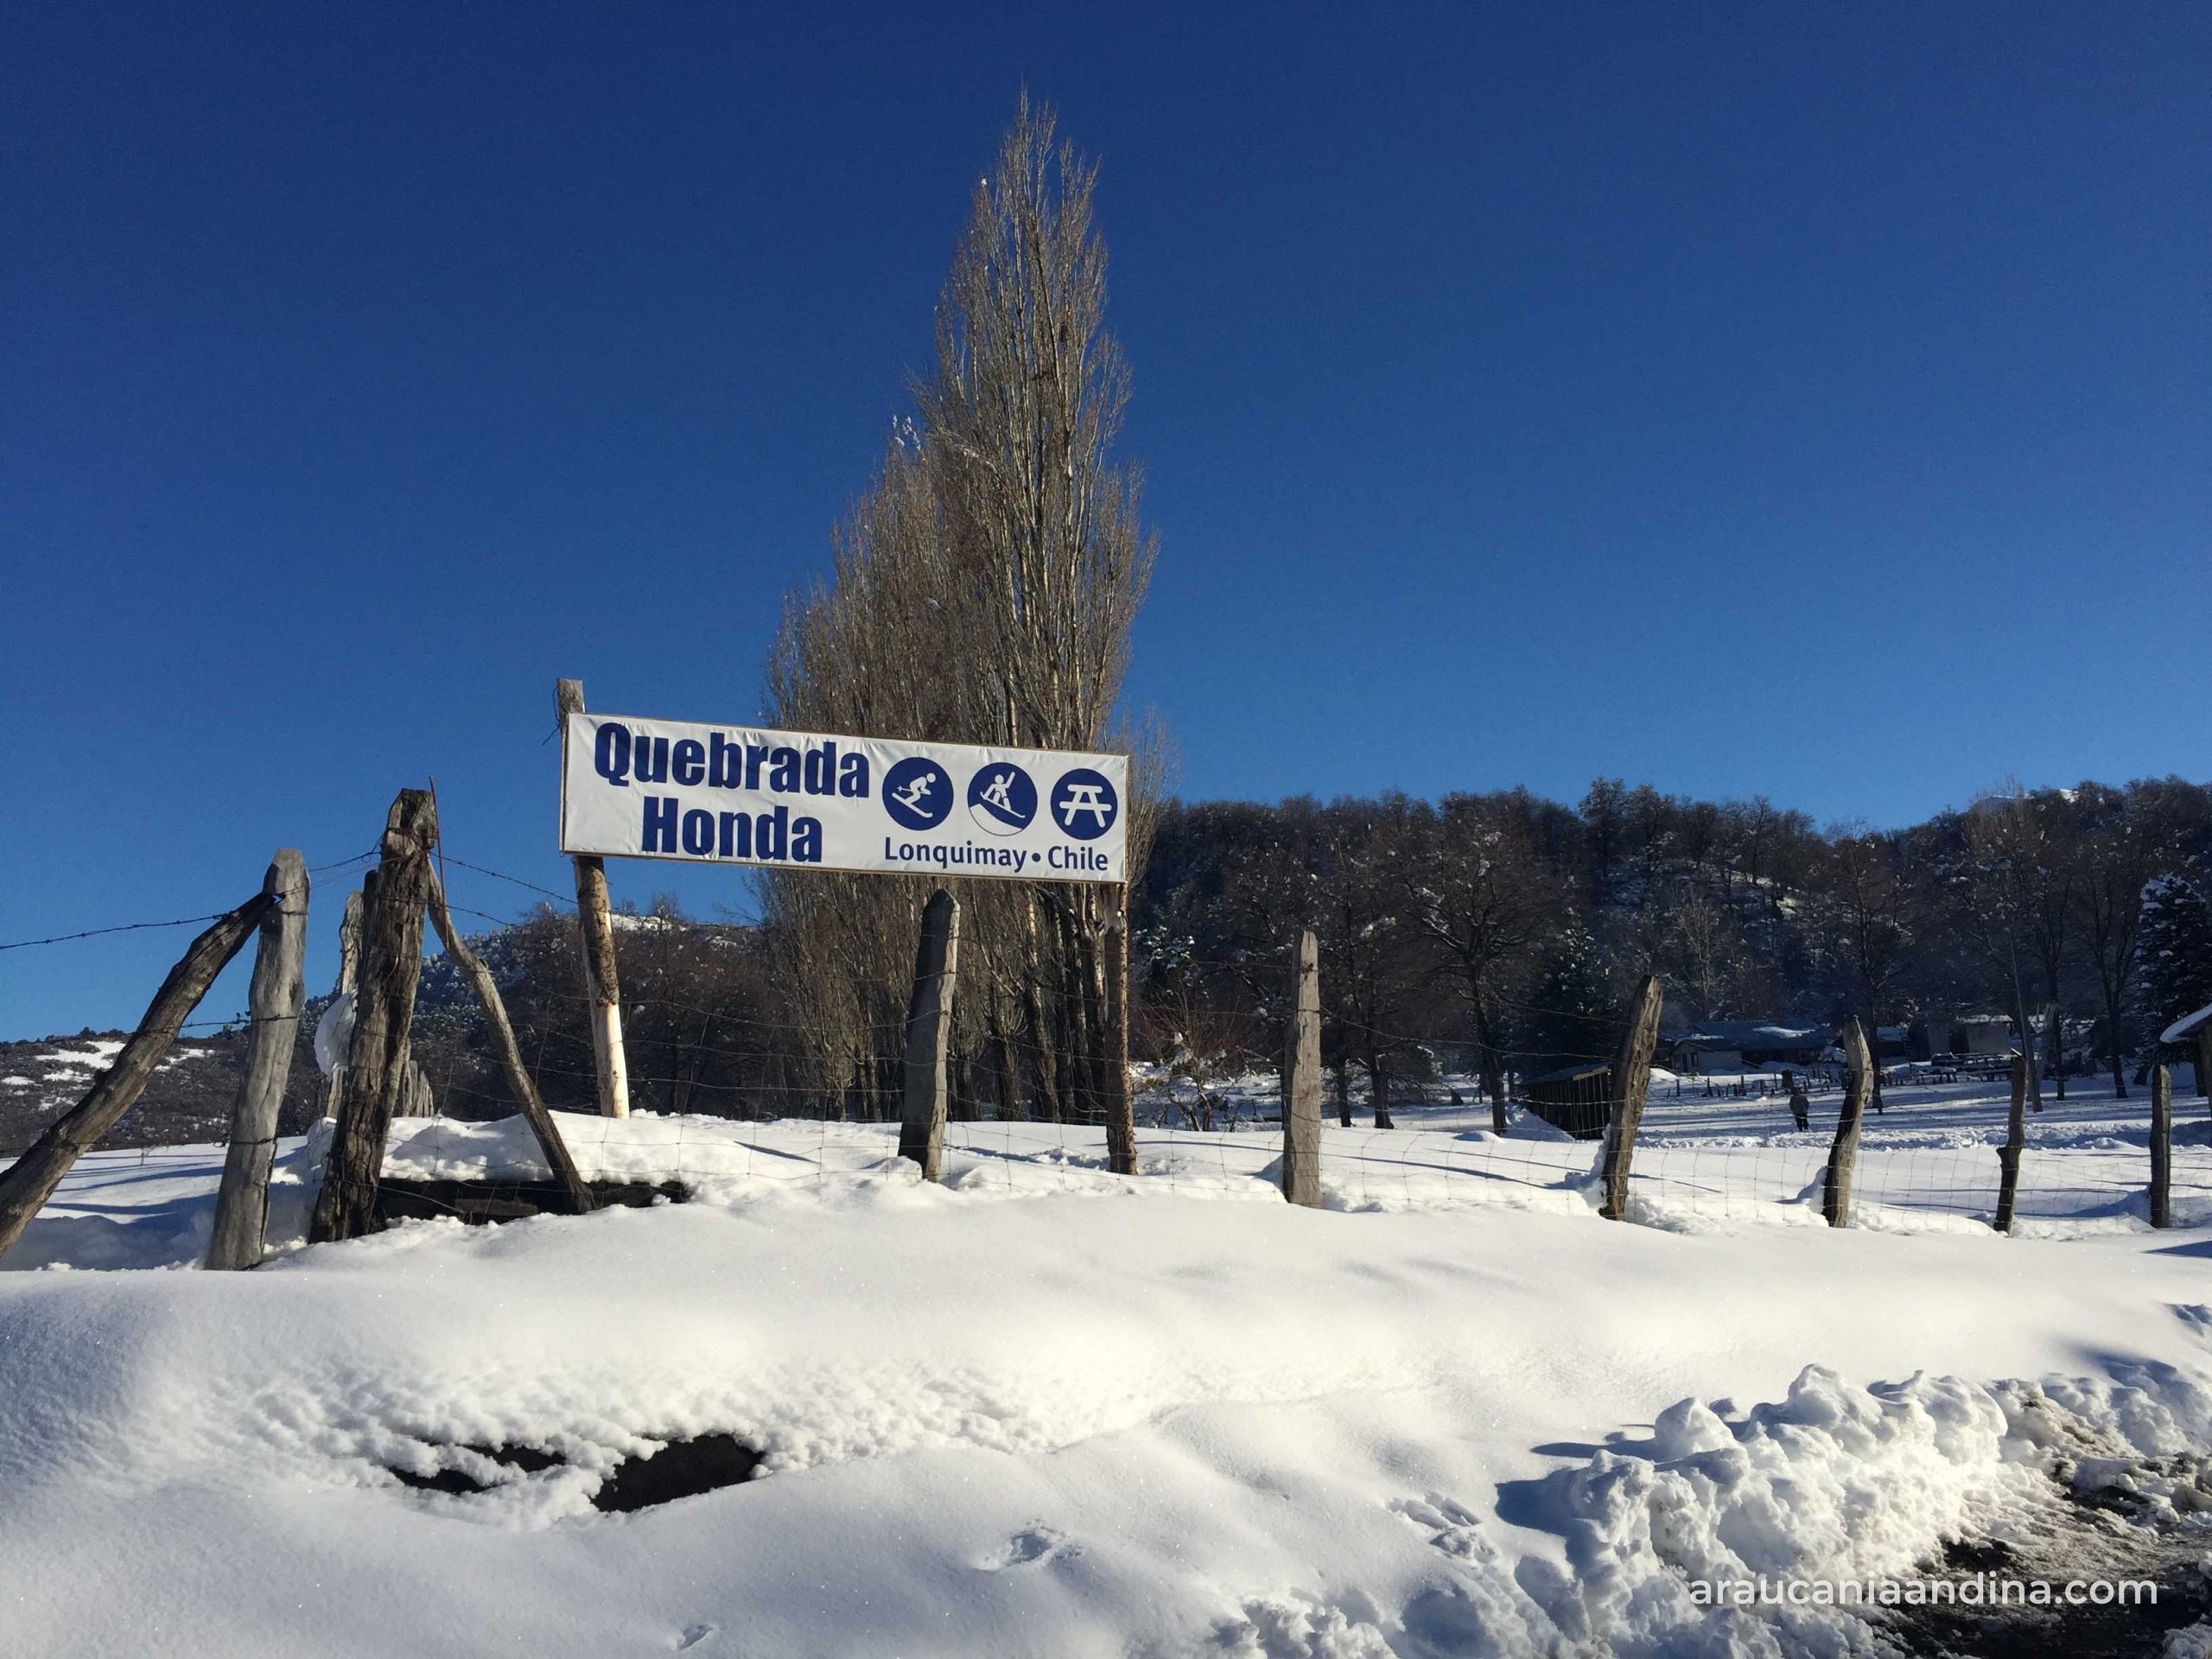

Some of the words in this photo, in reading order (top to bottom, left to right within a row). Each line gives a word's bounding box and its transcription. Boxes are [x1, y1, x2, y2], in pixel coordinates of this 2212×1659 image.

[594, 722, 870, 798] Quebrada
[641, 796, 823, 862] Honda
[885, 836, 1027, 874] Lonquimay
[1047, 845, 1109, 871] Chile
